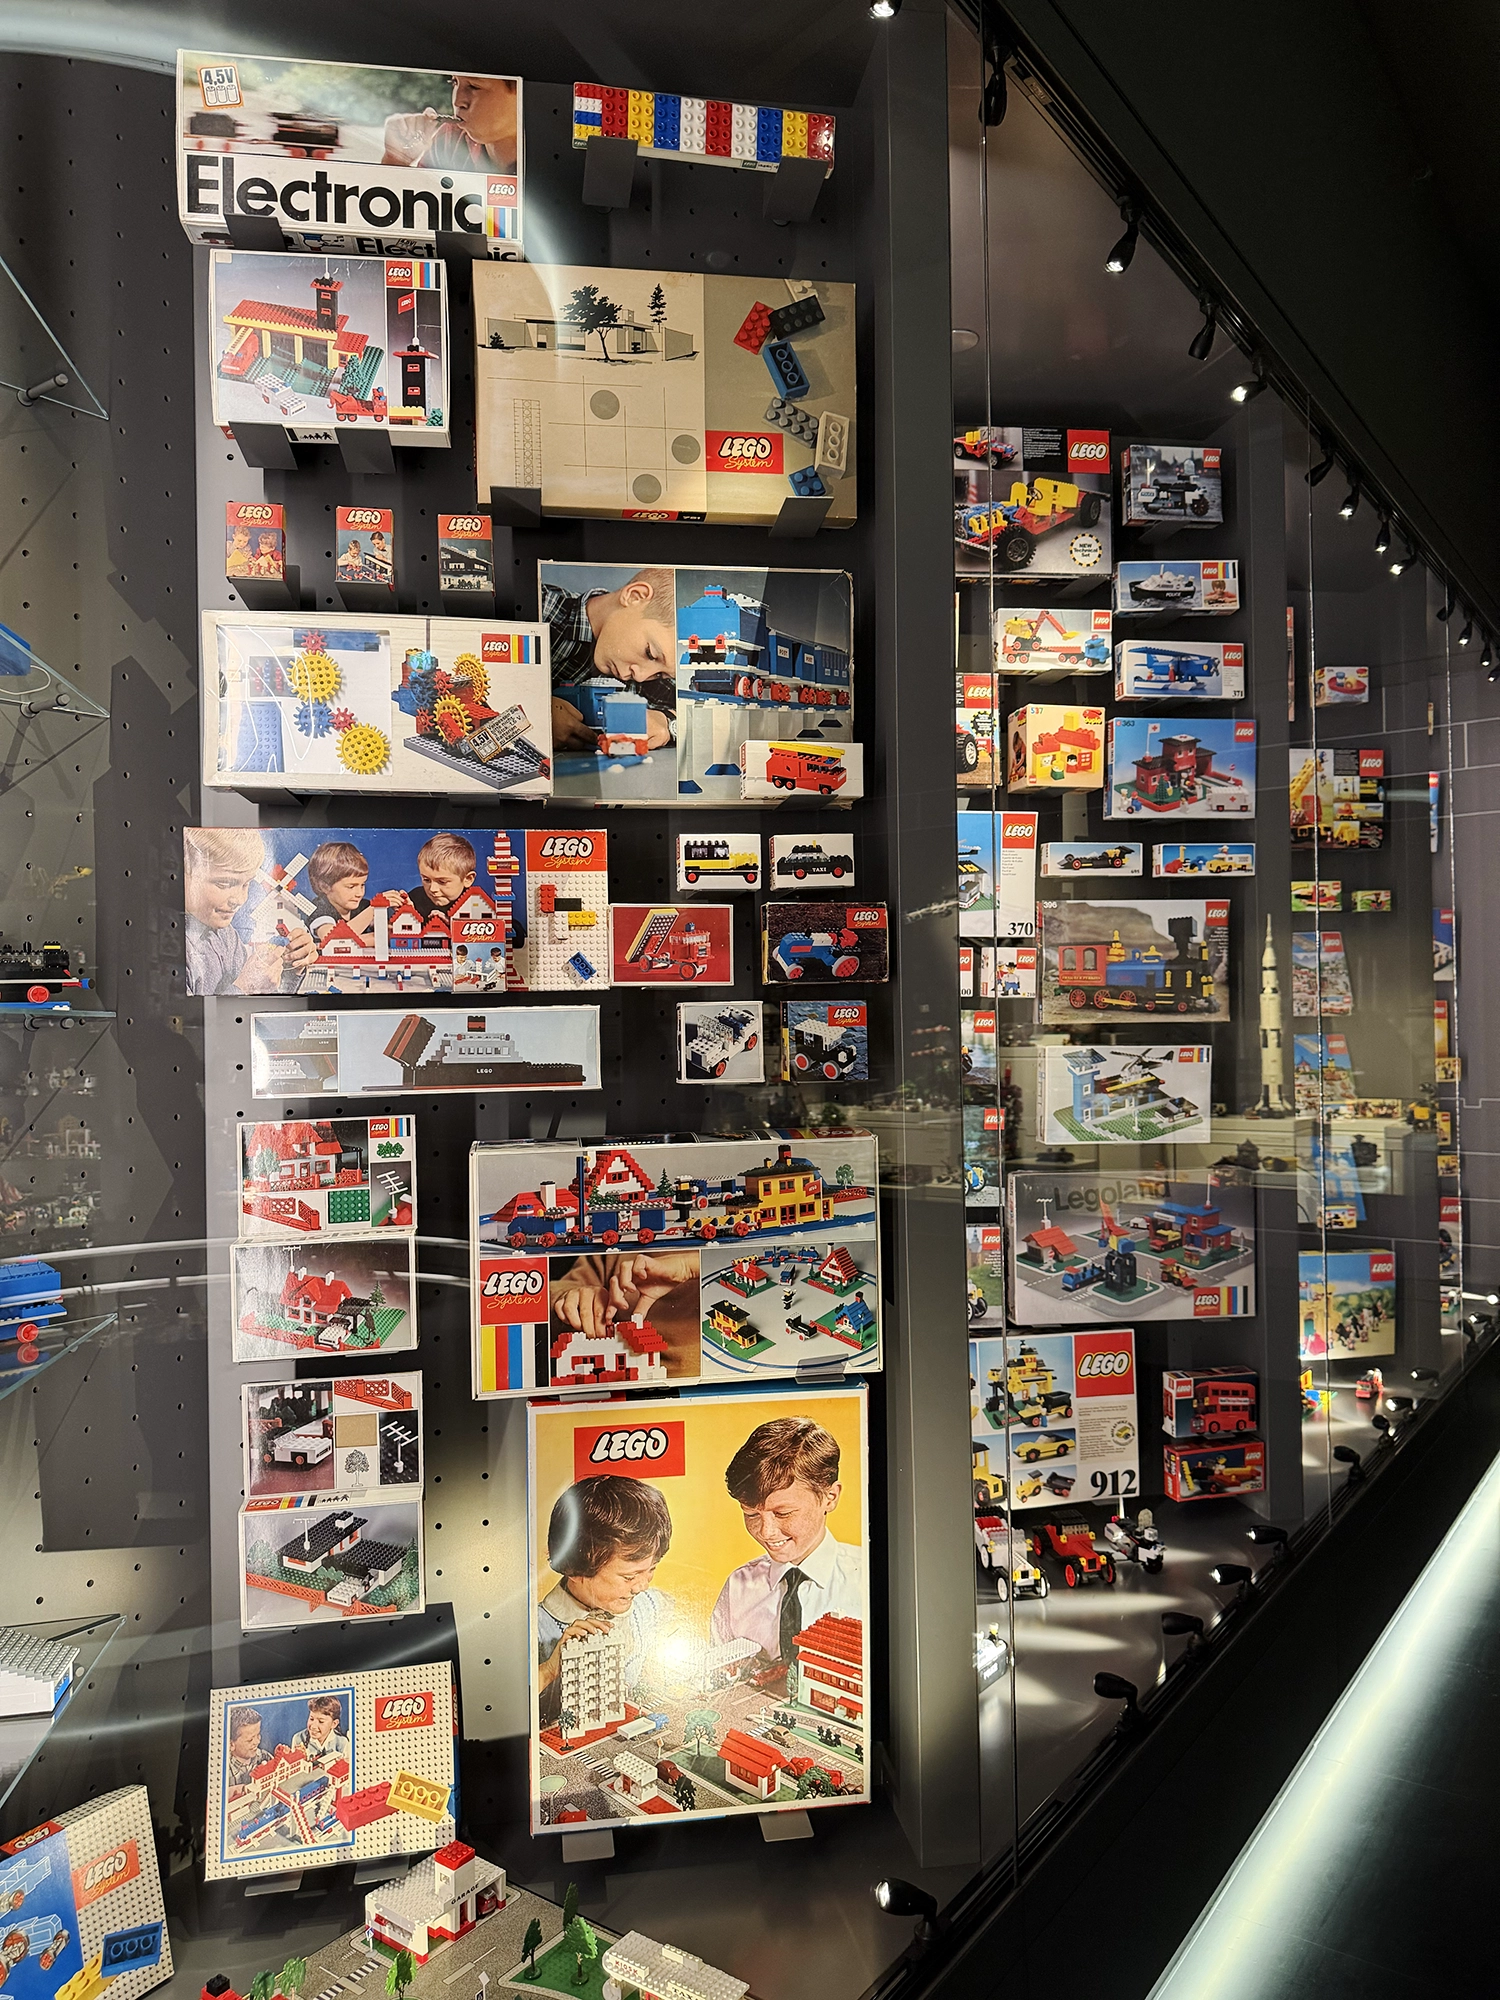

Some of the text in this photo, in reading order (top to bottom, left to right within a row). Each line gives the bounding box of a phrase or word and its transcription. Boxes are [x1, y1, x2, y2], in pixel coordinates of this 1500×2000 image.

[186, 154, 483, 233] Electronic
[488, 183, 516, 197] LEGO
[387, 267, 411, 278] LEGO
[719, 436, 772, 459] LEGO
[1069, 443, 1107, 460] LEGO
[724, 455, 773, 470] System
[237, 505, 273, 519] LEGO
[346, 510, 381, 524] LEGO
[632, 511, 670, 520] LEGO
[240, 517, 274, 527] System
[351, 521, 382, 531] System
[448, 517, 482, 531] LEGO
[450, 529, 484, 539] System
[1202, 565, 1217, 575] LEGO
[483, 641, 509, 652] LEGO
[1225, 651, 1241, 660] LEGO
[1030, 707, 1043, 715] 537
[1235, 728, 1254, 736] LEGO
[1361, 758, 1383, 767] LEGO
[1003, 823, 1034, 839] LEGO
[540, 836, 593, 857] LEGO
[544, 855, 593, 867] System
[1043, 901, 1058, 909] 396
[853, 911, 880, 921] LEGO
[1207, 909, 1227, 918] LEGO
[461, 922, 495, 936] LEGO
[1007, 922, 1034, 936] 370
[463, 934, 497, 943] System
[1018, 955, 1035, 963] LEGO
[833, 1008, 860, 1019] LEGO
[976, 1018, 994, 1026] LEGO
[985, 1115, 1003, 1124] LEGO
[370, 1123, 389, 1131] LEGO
[1054, 1180, 1170, 1212] Legoland
[1371, 1263, 1393, 1273] LEGO
[482, 1271, 544, 1296] LEGO
[487, 1293, 542, 1309] System
[1194, 1294, 1220, 1305] LEGO
[1079, 1352, 1130, 1377] LEGO
[590, 1428, 668, 1463] LEGO
[1246, 1451, 1261, 1460] LEGO
[1090, 1469, 1138, 1498] 912
[249, 1499, 280, 1507] LEGO
[381, 1695, 426, 1720] LEGO
[386, 1715, 427, 1729] System
[14, 1827, 50, 1849] LEGO
[84, 1850, 128, 1891] LEGO
[89, 1866, 131, 1898] System
[451, 1882, 480, 1905] GARAGE
[615, 1960, 639, 1975] KIOSK
